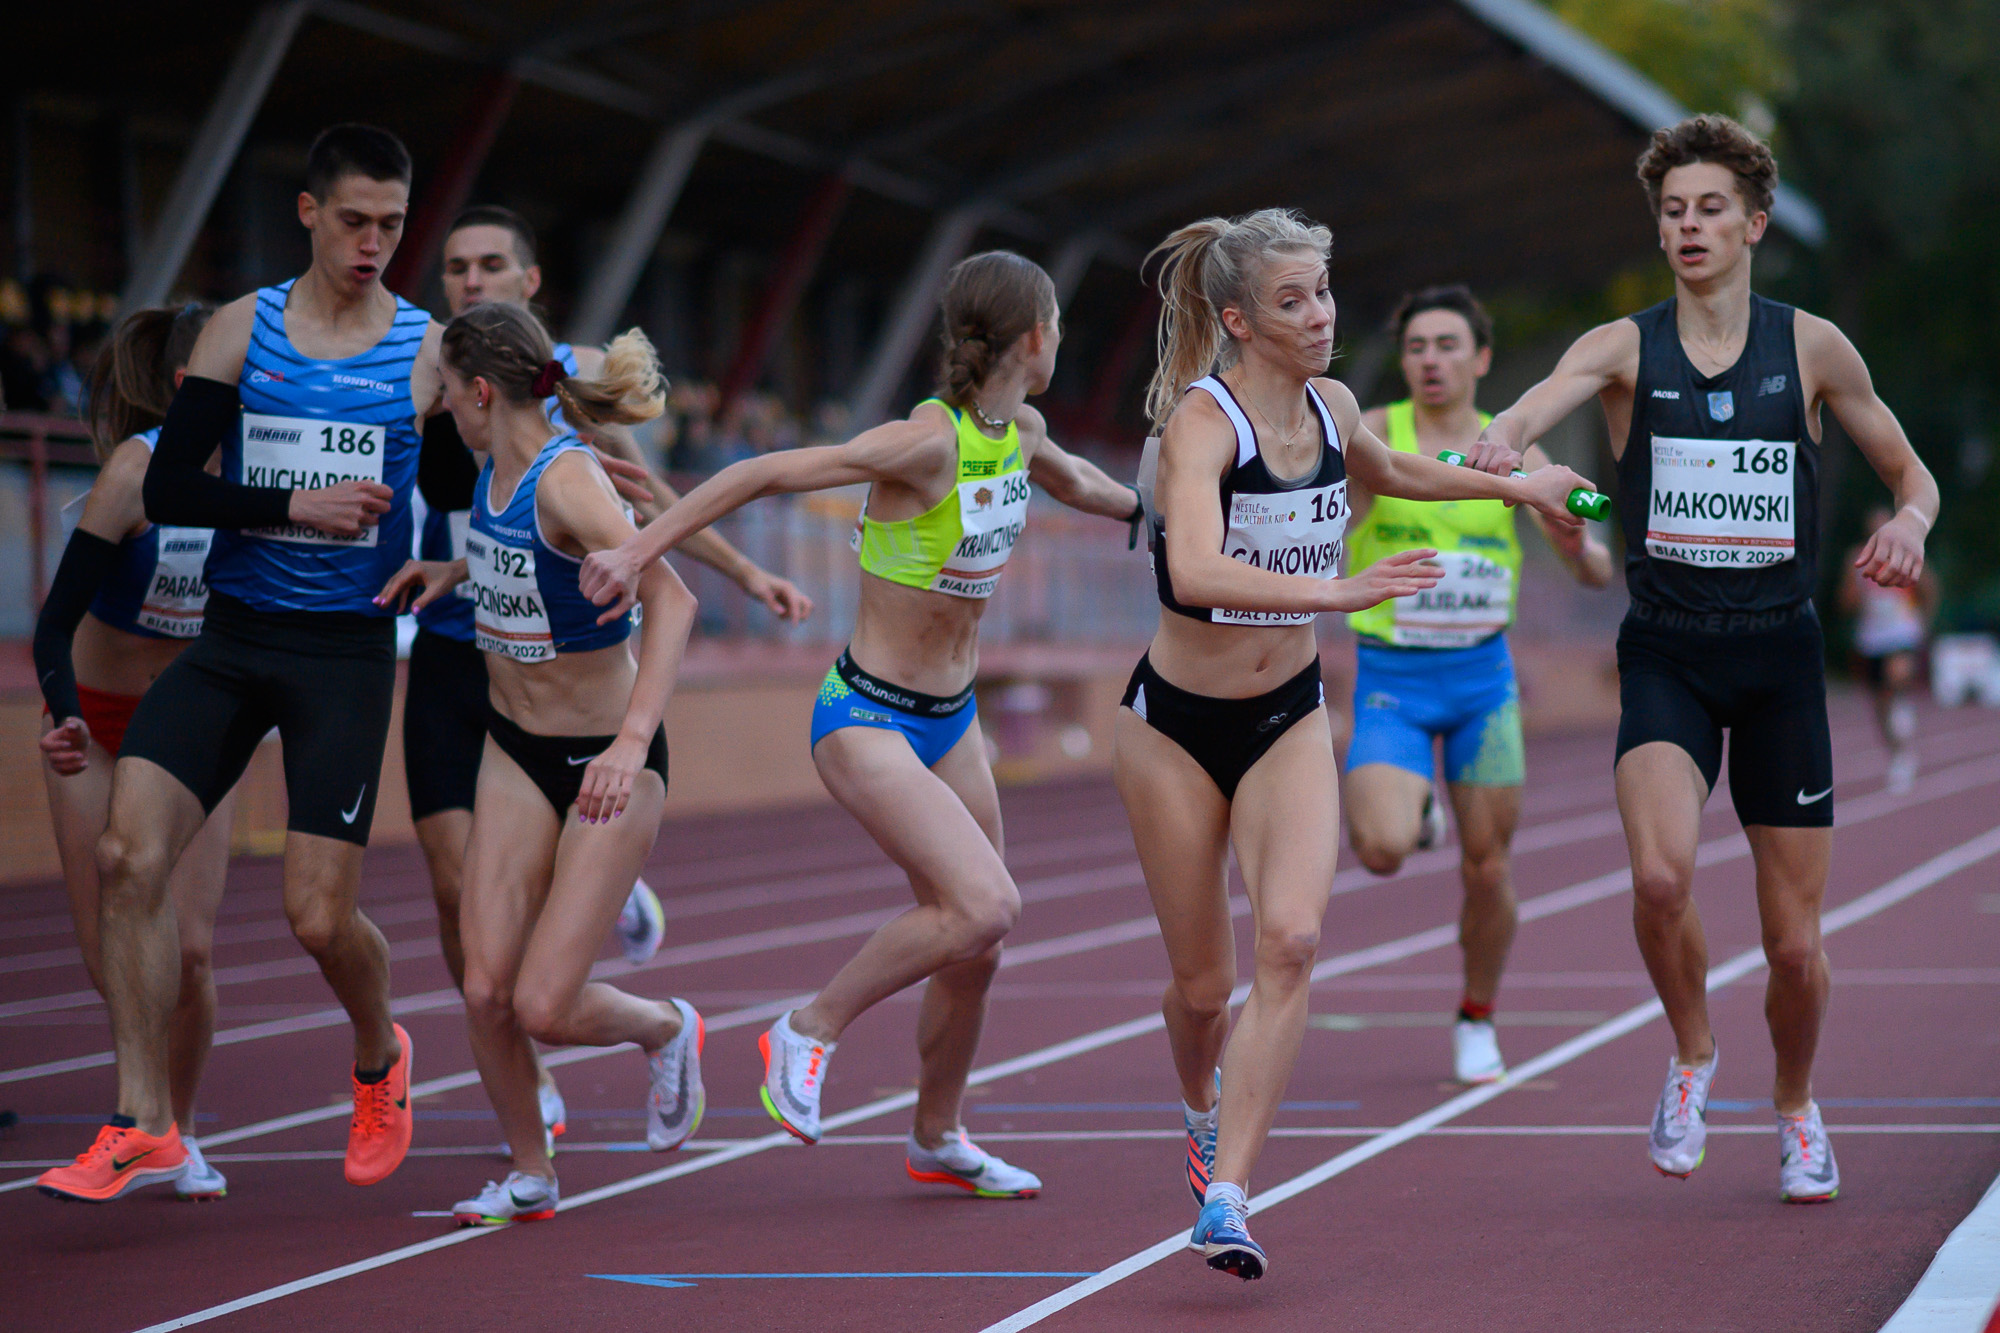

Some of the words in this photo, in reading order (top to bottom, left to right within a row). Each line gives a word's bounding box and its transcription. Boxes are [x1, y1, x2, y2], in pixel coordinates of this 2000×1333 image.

[320, 427, 375, 455] 186
[1732, 446, 1788, 474] 168
[247, 466, 376, 490] KUCHAR
[1261, 505, 1270, 513] for
[1310, 487, 1346, 523] 167
[1653, 488, 1789, 522] MAKOWSKI
[1234, 513, 1273, 525] HEALTHIER
[1274, 512, 1288, 523] KIDS
[493, 546, 528, 578] 192
[1655, 545, 1740, 562] BIAŁYSTOK
[1746, 551, 1785, 564] 2022
[513, 645, 546, 658] 2022
